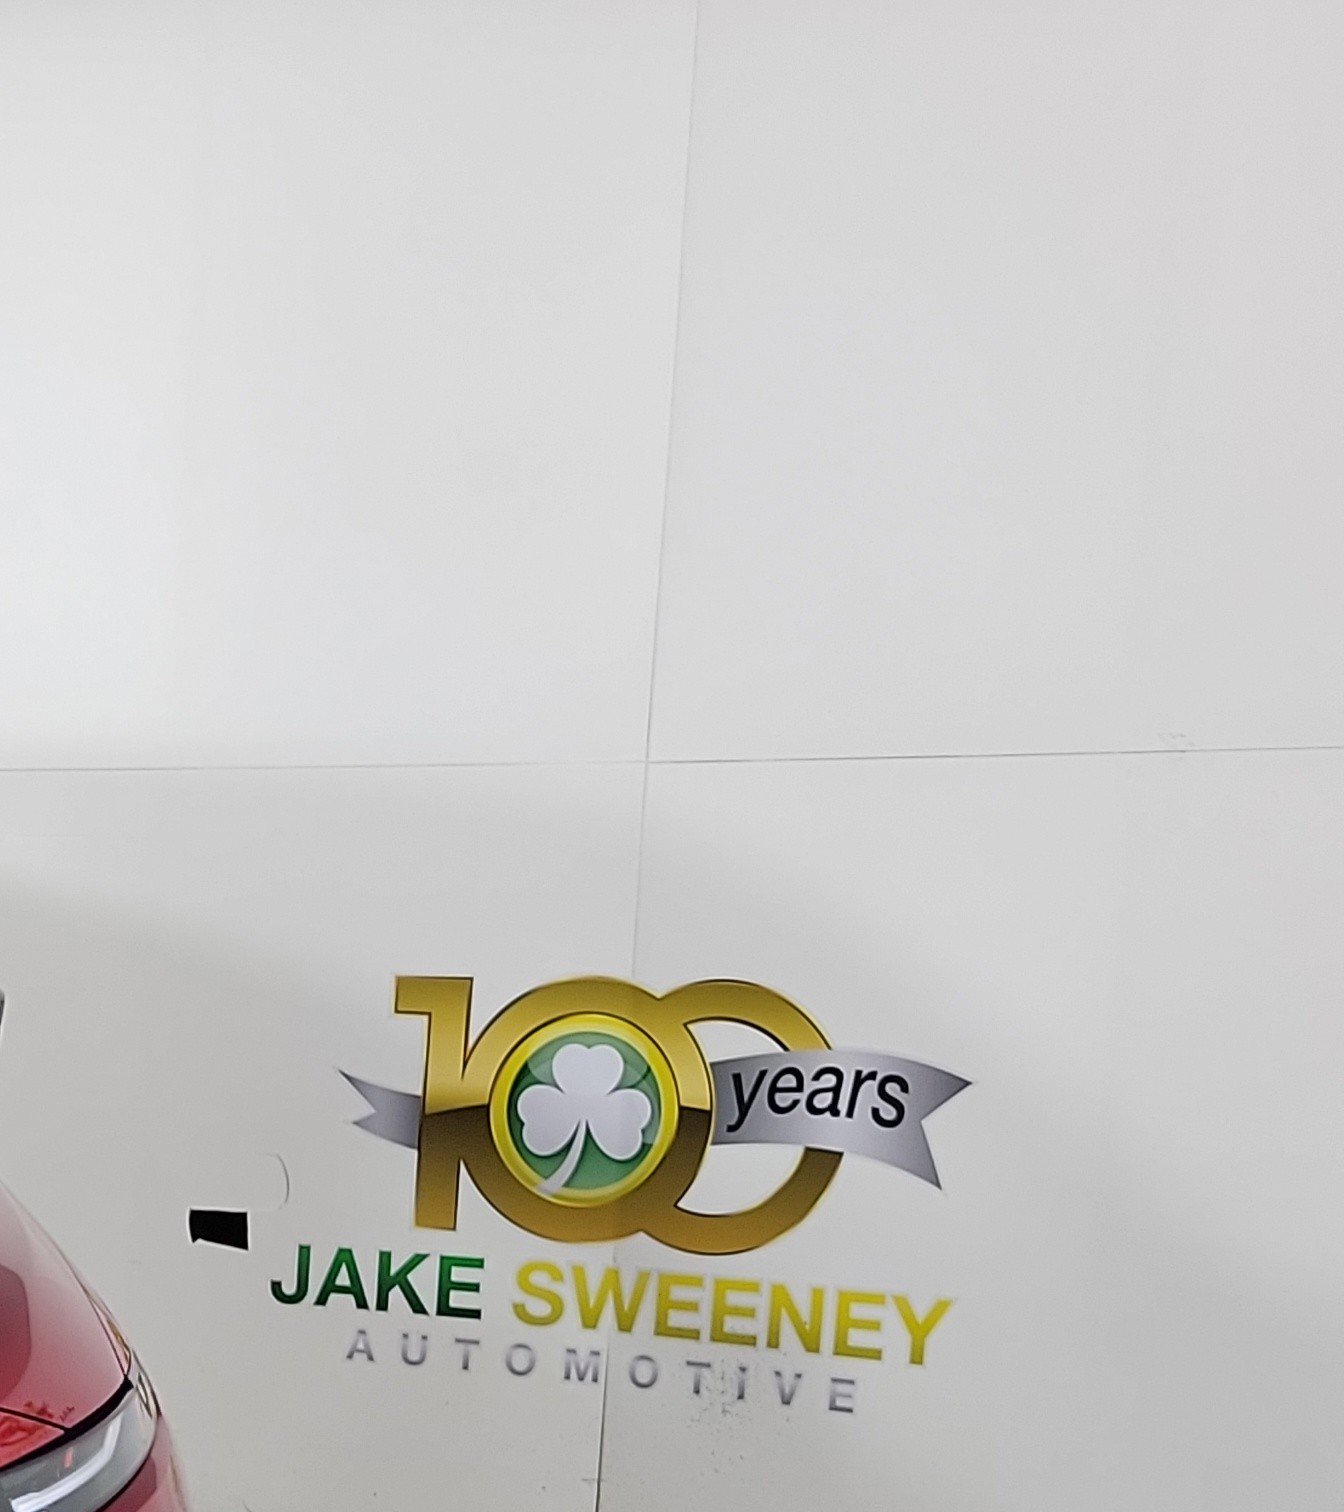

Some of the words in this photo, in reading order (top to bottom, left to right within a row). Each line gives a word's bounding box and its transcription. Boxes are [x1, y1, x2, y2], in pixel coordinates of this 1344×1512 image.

[393, 974, 845, 1256] 100
[725, 1065, 911, 1133] years
[269, 1243, 486, 1321] JAKE
[511, 1260, 953, 1367] SWEENEY
[345, 1328, 856, 1415] AUTOMOTIVE
